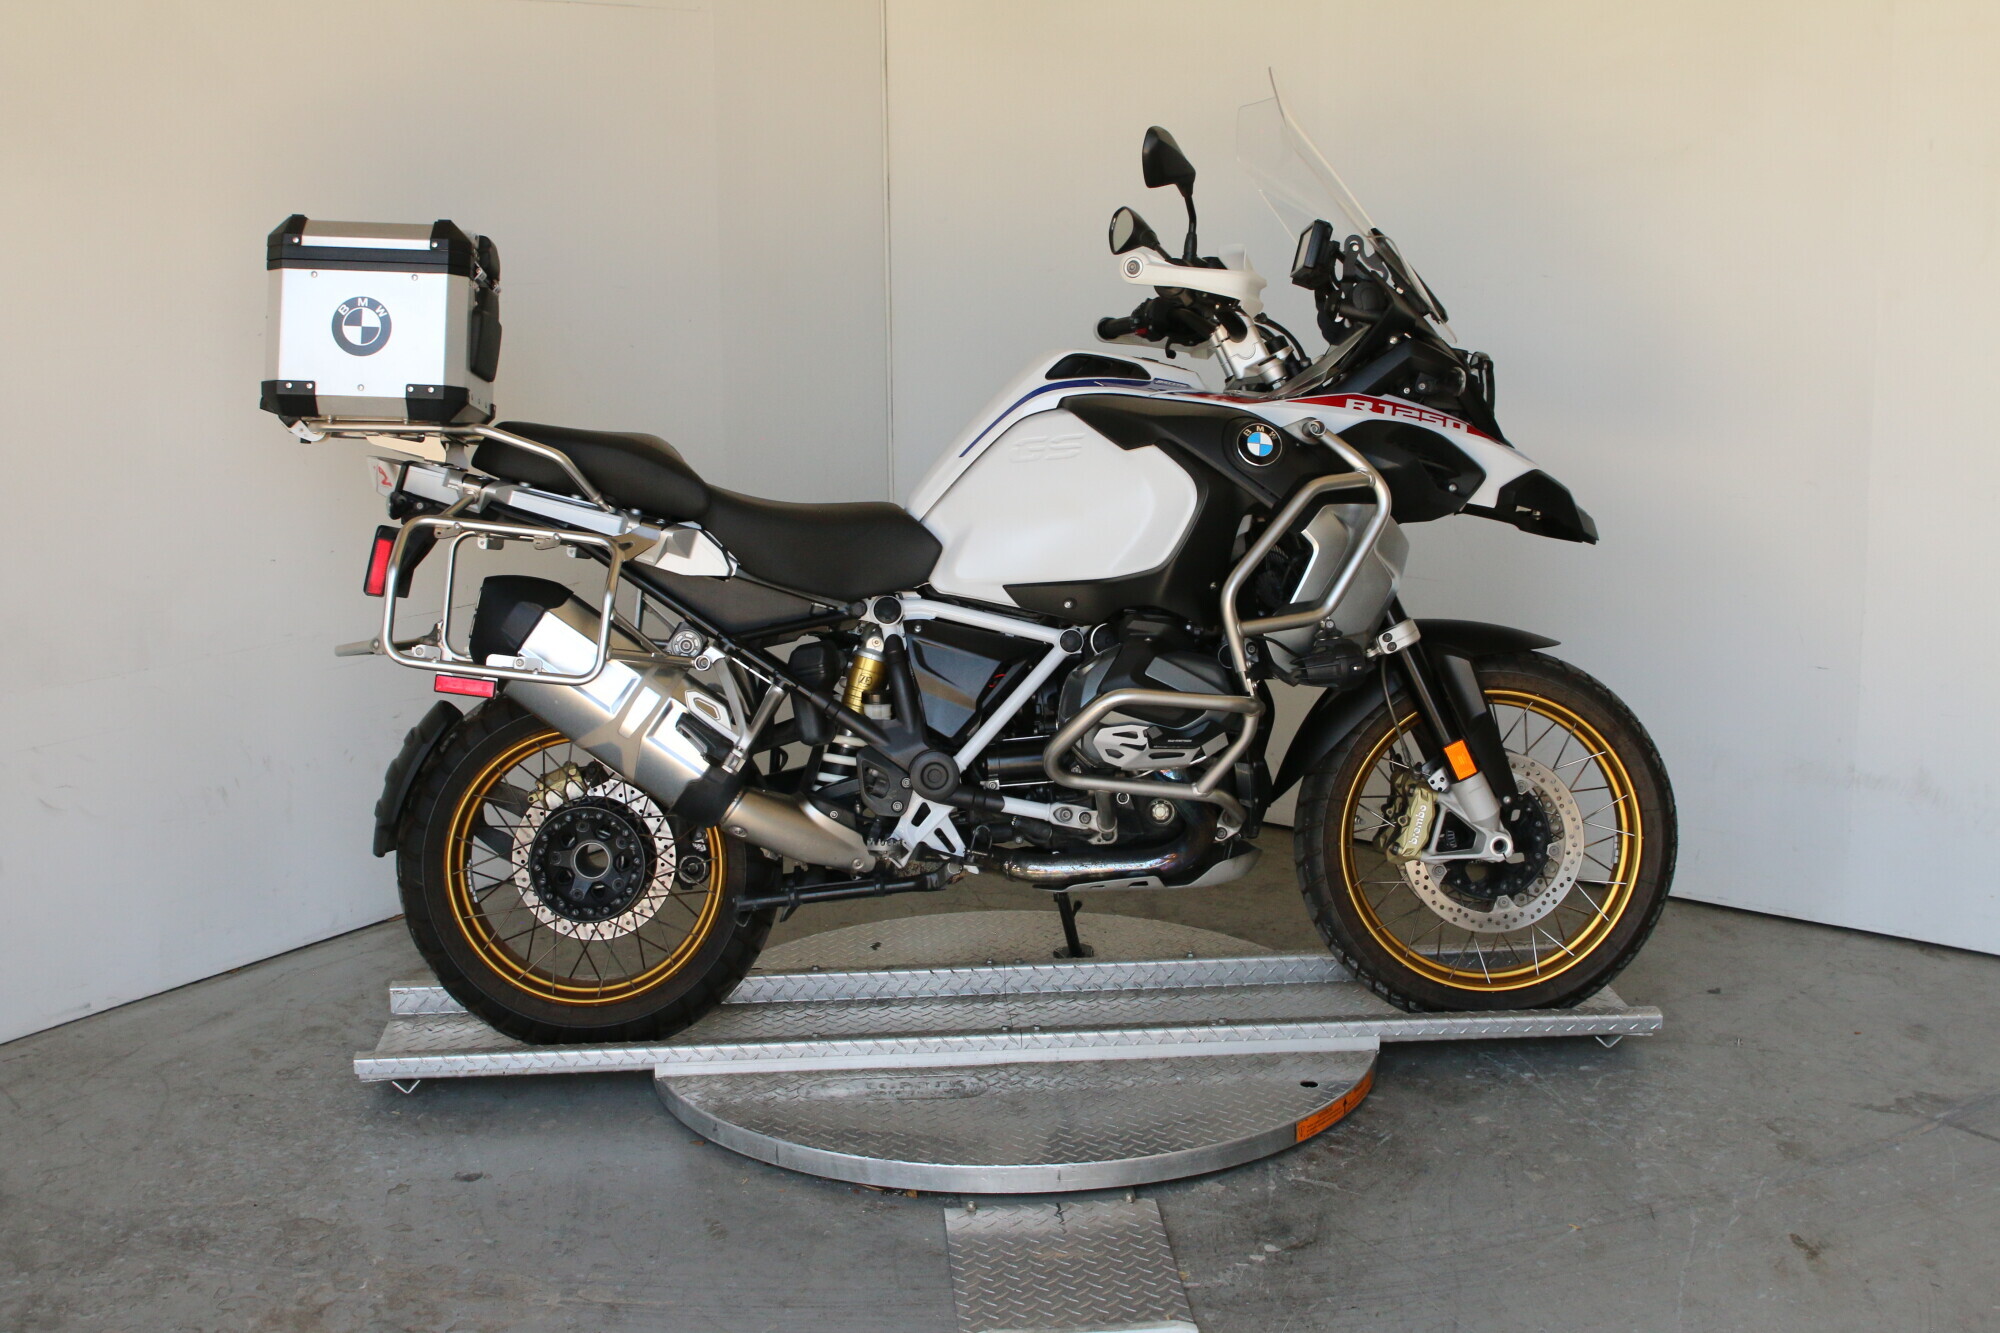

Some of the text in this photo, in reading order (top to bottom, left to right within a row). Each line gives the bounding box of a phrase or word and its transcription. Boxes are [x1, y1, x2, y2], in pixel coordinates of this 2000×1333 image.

[338, 298, 388, 318] BMW
[1243, 425, 1278, 440] BMW
[1409, 805, 1427, 845] brembo
